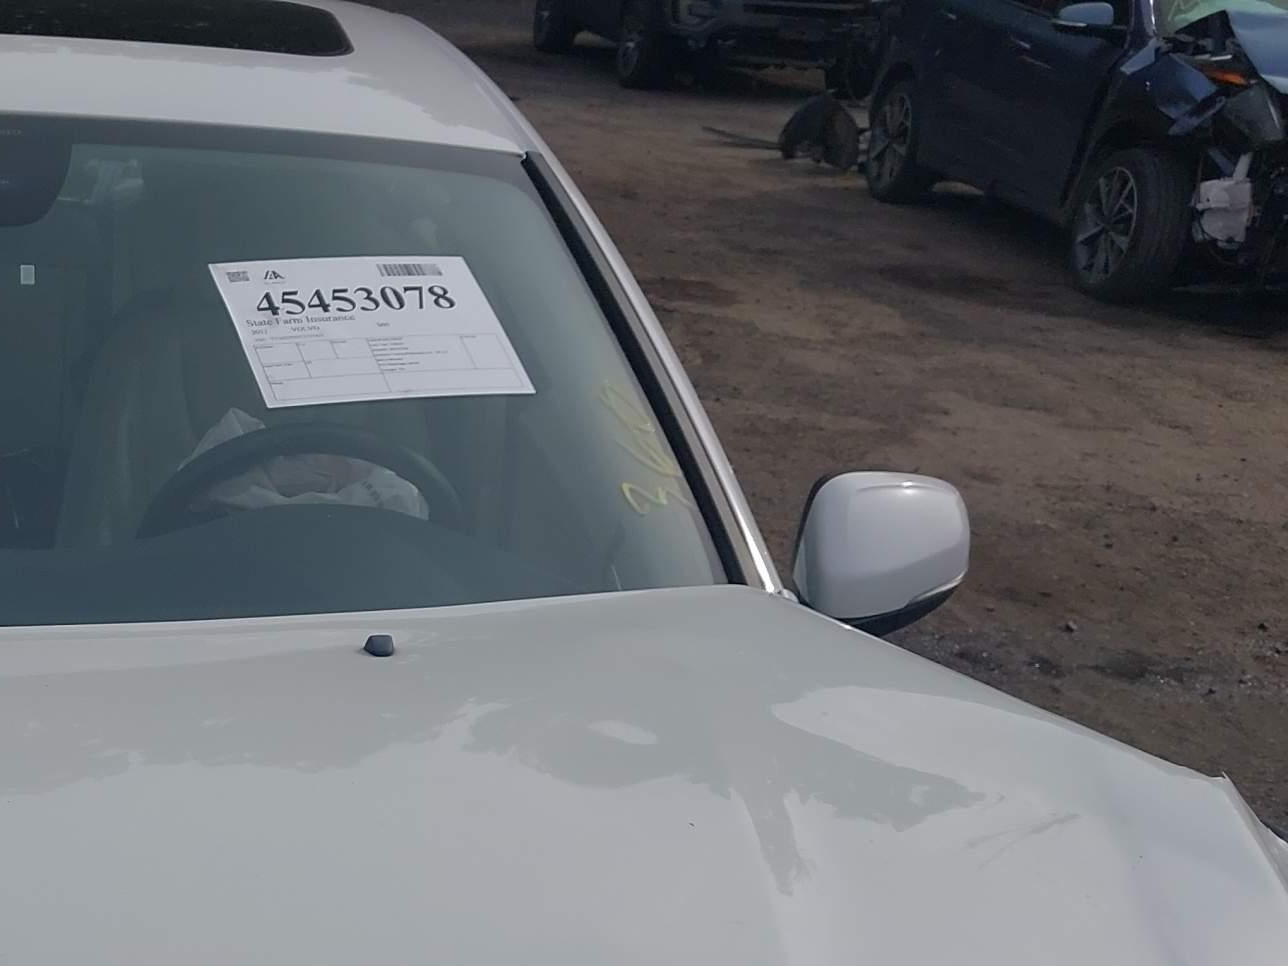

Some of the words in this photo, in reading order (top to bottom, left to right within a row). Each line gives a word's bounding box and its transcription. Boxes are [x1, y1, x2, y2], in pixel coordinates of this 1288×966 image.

[256, 285, 456, 316] 45453078
[246, 318, 273, 328] State
[276, 313, 305, 325] Farm
[309, 313, 356, 323] Insurance
